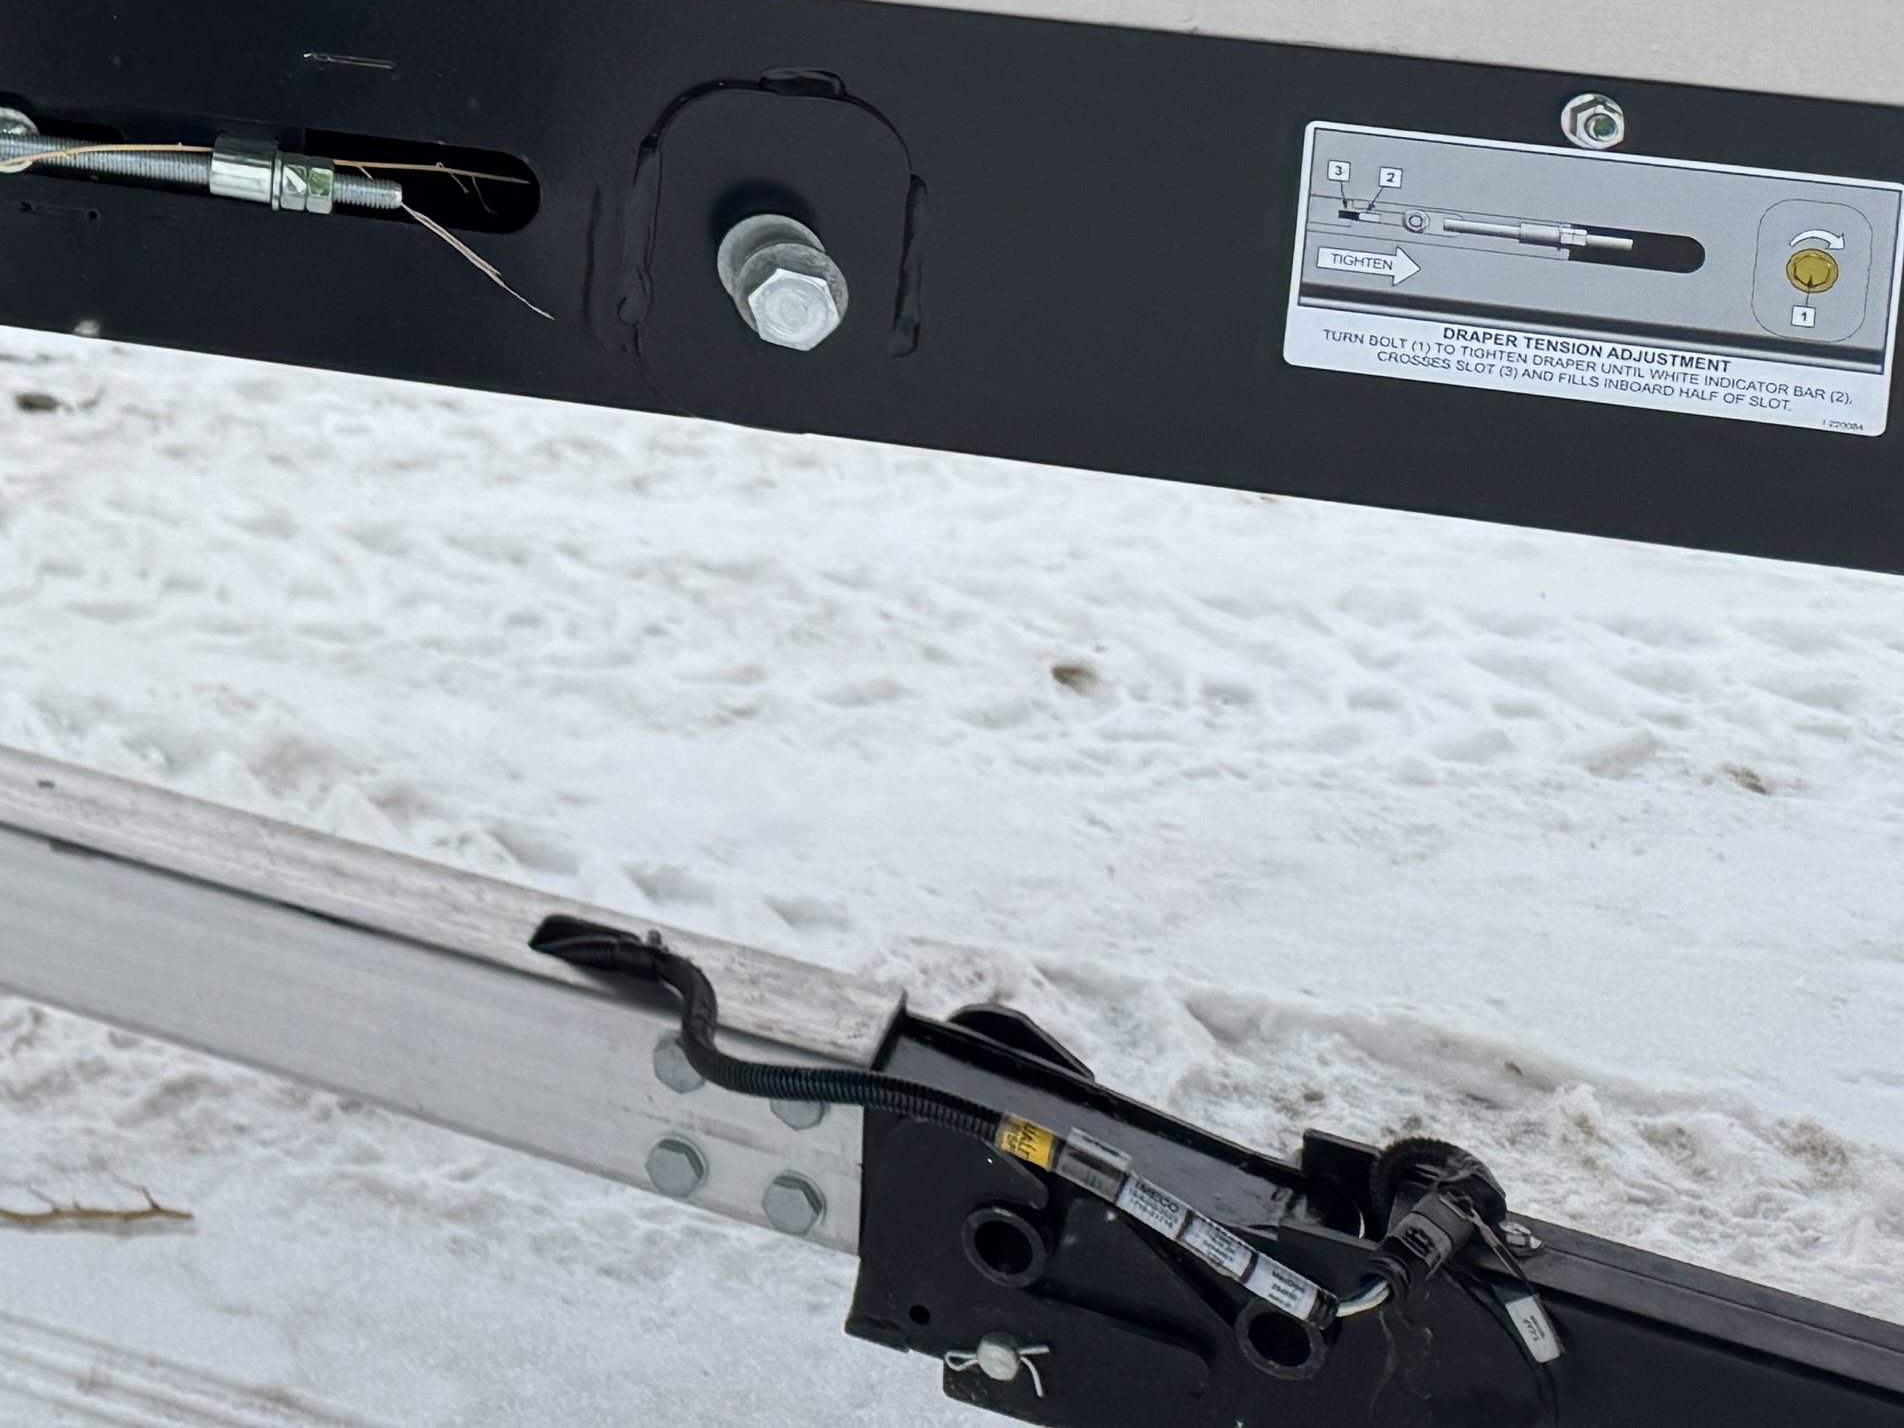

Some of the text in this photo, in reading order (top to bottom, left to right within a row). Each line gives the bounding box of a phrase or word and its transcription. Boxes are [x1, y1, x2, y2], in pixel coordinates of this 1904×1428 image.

[1334, 166, 1343, 175] 3
[1386, 172, 1396, 183] 2
[1332, 253, 1393, 270] TIGHTEN
[1801, 311, 1807, 321] 1
[1443, 327, 1731, 373] DRAPER TENSION ADJUSTMENT
[1323, 329, 1364, 345] TURN
[1369, 335, 1407, 349] BOLT
[1411, 339, 1431, 353] (1)
[1435, 342, 1455, 355] TO
[1461, 346, 1527, 364] TIGHTEN
[1533, 354, 1596, 373] DRAPER
[1601, 363, 1645, 379] UNTIL
[1650, 368, 1699, 385] WHITE
[1705, 376, 1789, 395] INDICATOR
[1793, 386, 1825, 400] BAR
[1377, 351, 1451, 370] CROSSES
[1455, 360, 1496, 375] SLOT
[1499, 365, 1518, 379] (3)
[1522, 368, 1554, 382] AND
[1558, 373, 1599, 388] FILLS
[1604, 379, 1674, 396] INBOARD
[1679, 387, 1719, 401] HALF
[1723, 393, 1744, 405] OF
